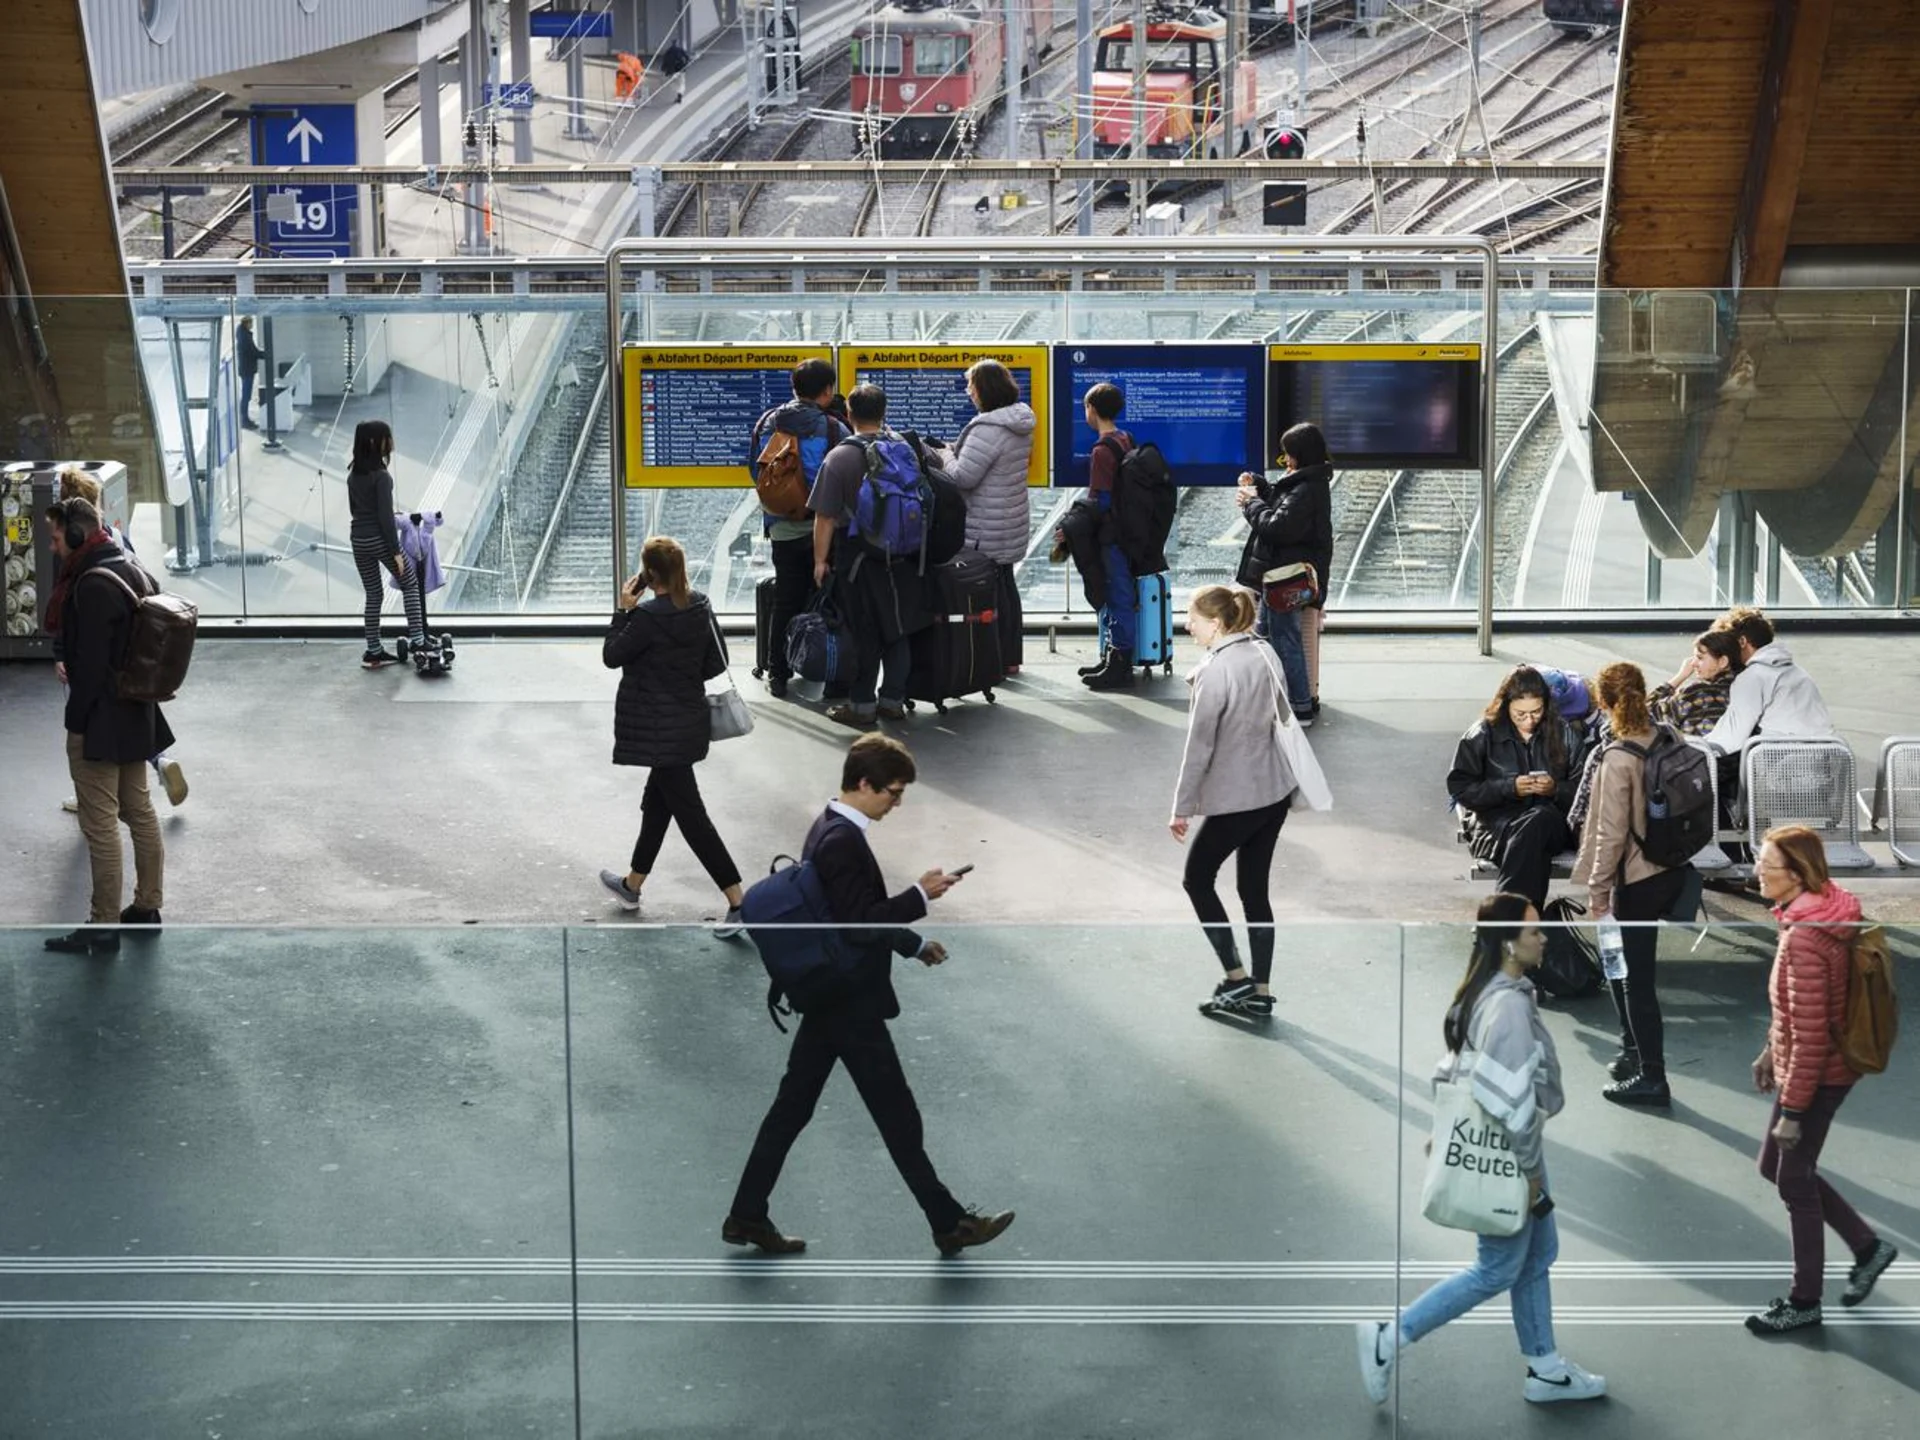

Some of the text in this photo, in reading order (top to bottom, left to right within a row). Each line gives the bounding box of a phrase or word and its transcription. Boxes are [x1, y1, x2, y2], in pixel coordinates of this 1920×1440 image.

[657, 352, 798, 365] Abfahrt Départ Partenza
[873, 352, 916, 363] Abfahrt
[919, 352, 958, 364] Départ
